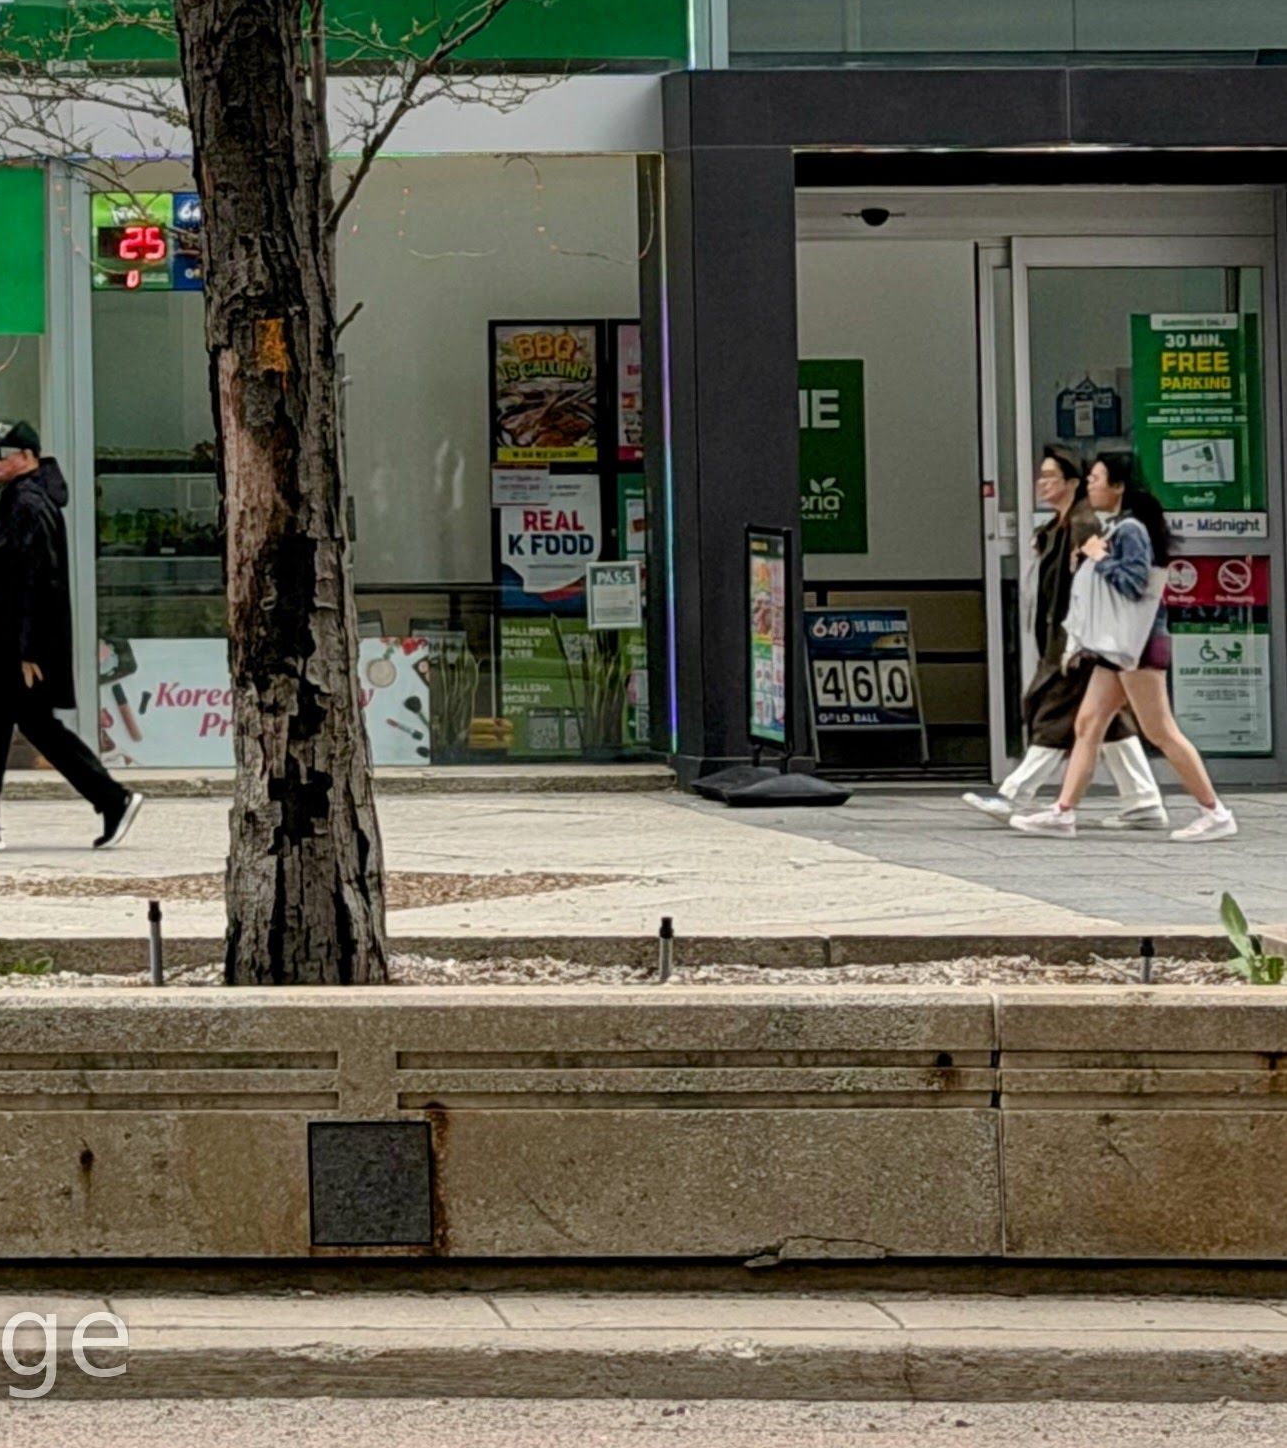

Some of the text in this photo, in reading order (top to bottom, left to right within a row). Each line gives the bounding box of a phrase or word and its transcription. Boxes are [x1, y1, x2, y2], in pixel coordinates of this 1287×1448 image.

[119, 226, 166, 260] 25
[513, 332, 578, 361] BBQ
[1164, 333, 1226, 348] 30 MIN.
[519, 359, 593, 382] CALLING
[1161, 351, 1231, 373] FREE
[1160, 376, 1232, 390] PARKING
[522, 510, 585, 532] REAL
[1196, 517, 1261, 534] Midnight
[508, 533, 595, 556] K FOOD
[595, 570, 633, 585] PASS
[154, 681, 234, 708] Korea
